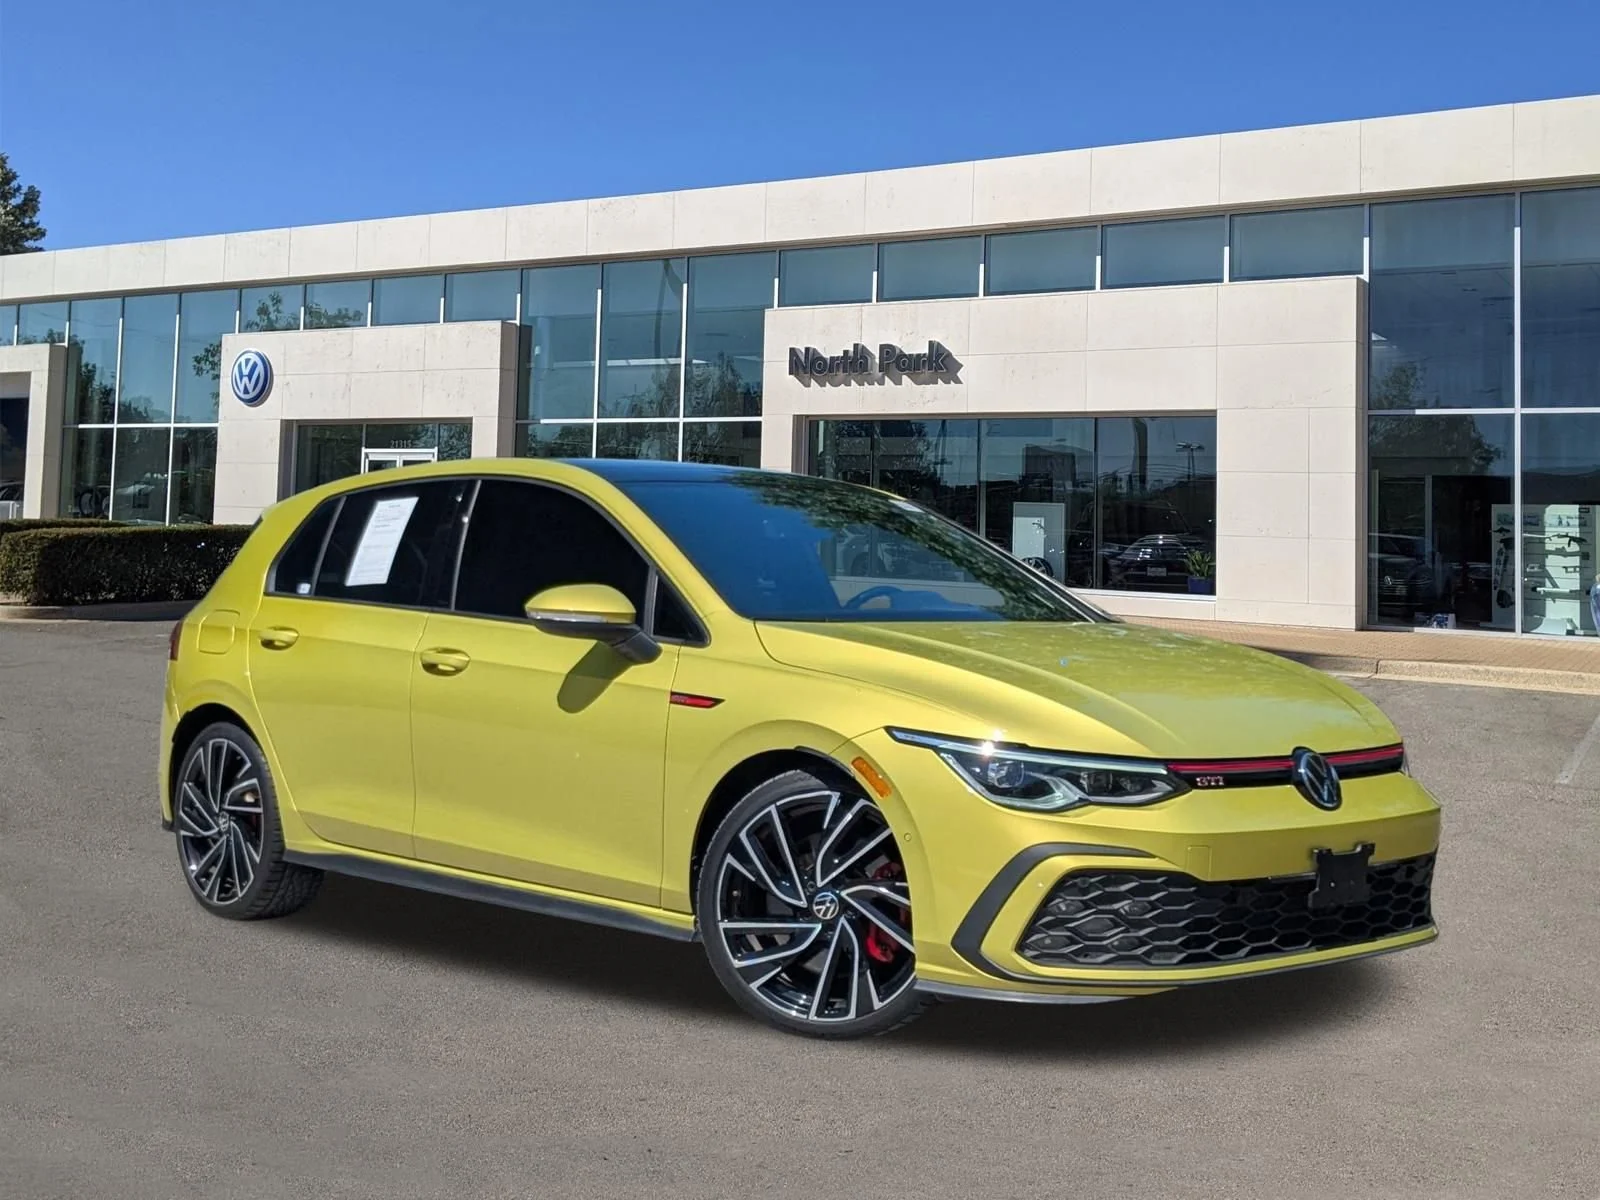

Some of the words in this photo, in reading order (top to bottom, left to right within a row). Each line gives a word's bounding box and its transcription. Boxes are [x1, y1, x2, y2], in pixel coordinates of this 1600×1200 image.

[788, 343, 872, 376] North
[878, 340, 950, 374] Park
[1196, 776, 1224, 786] GTI
